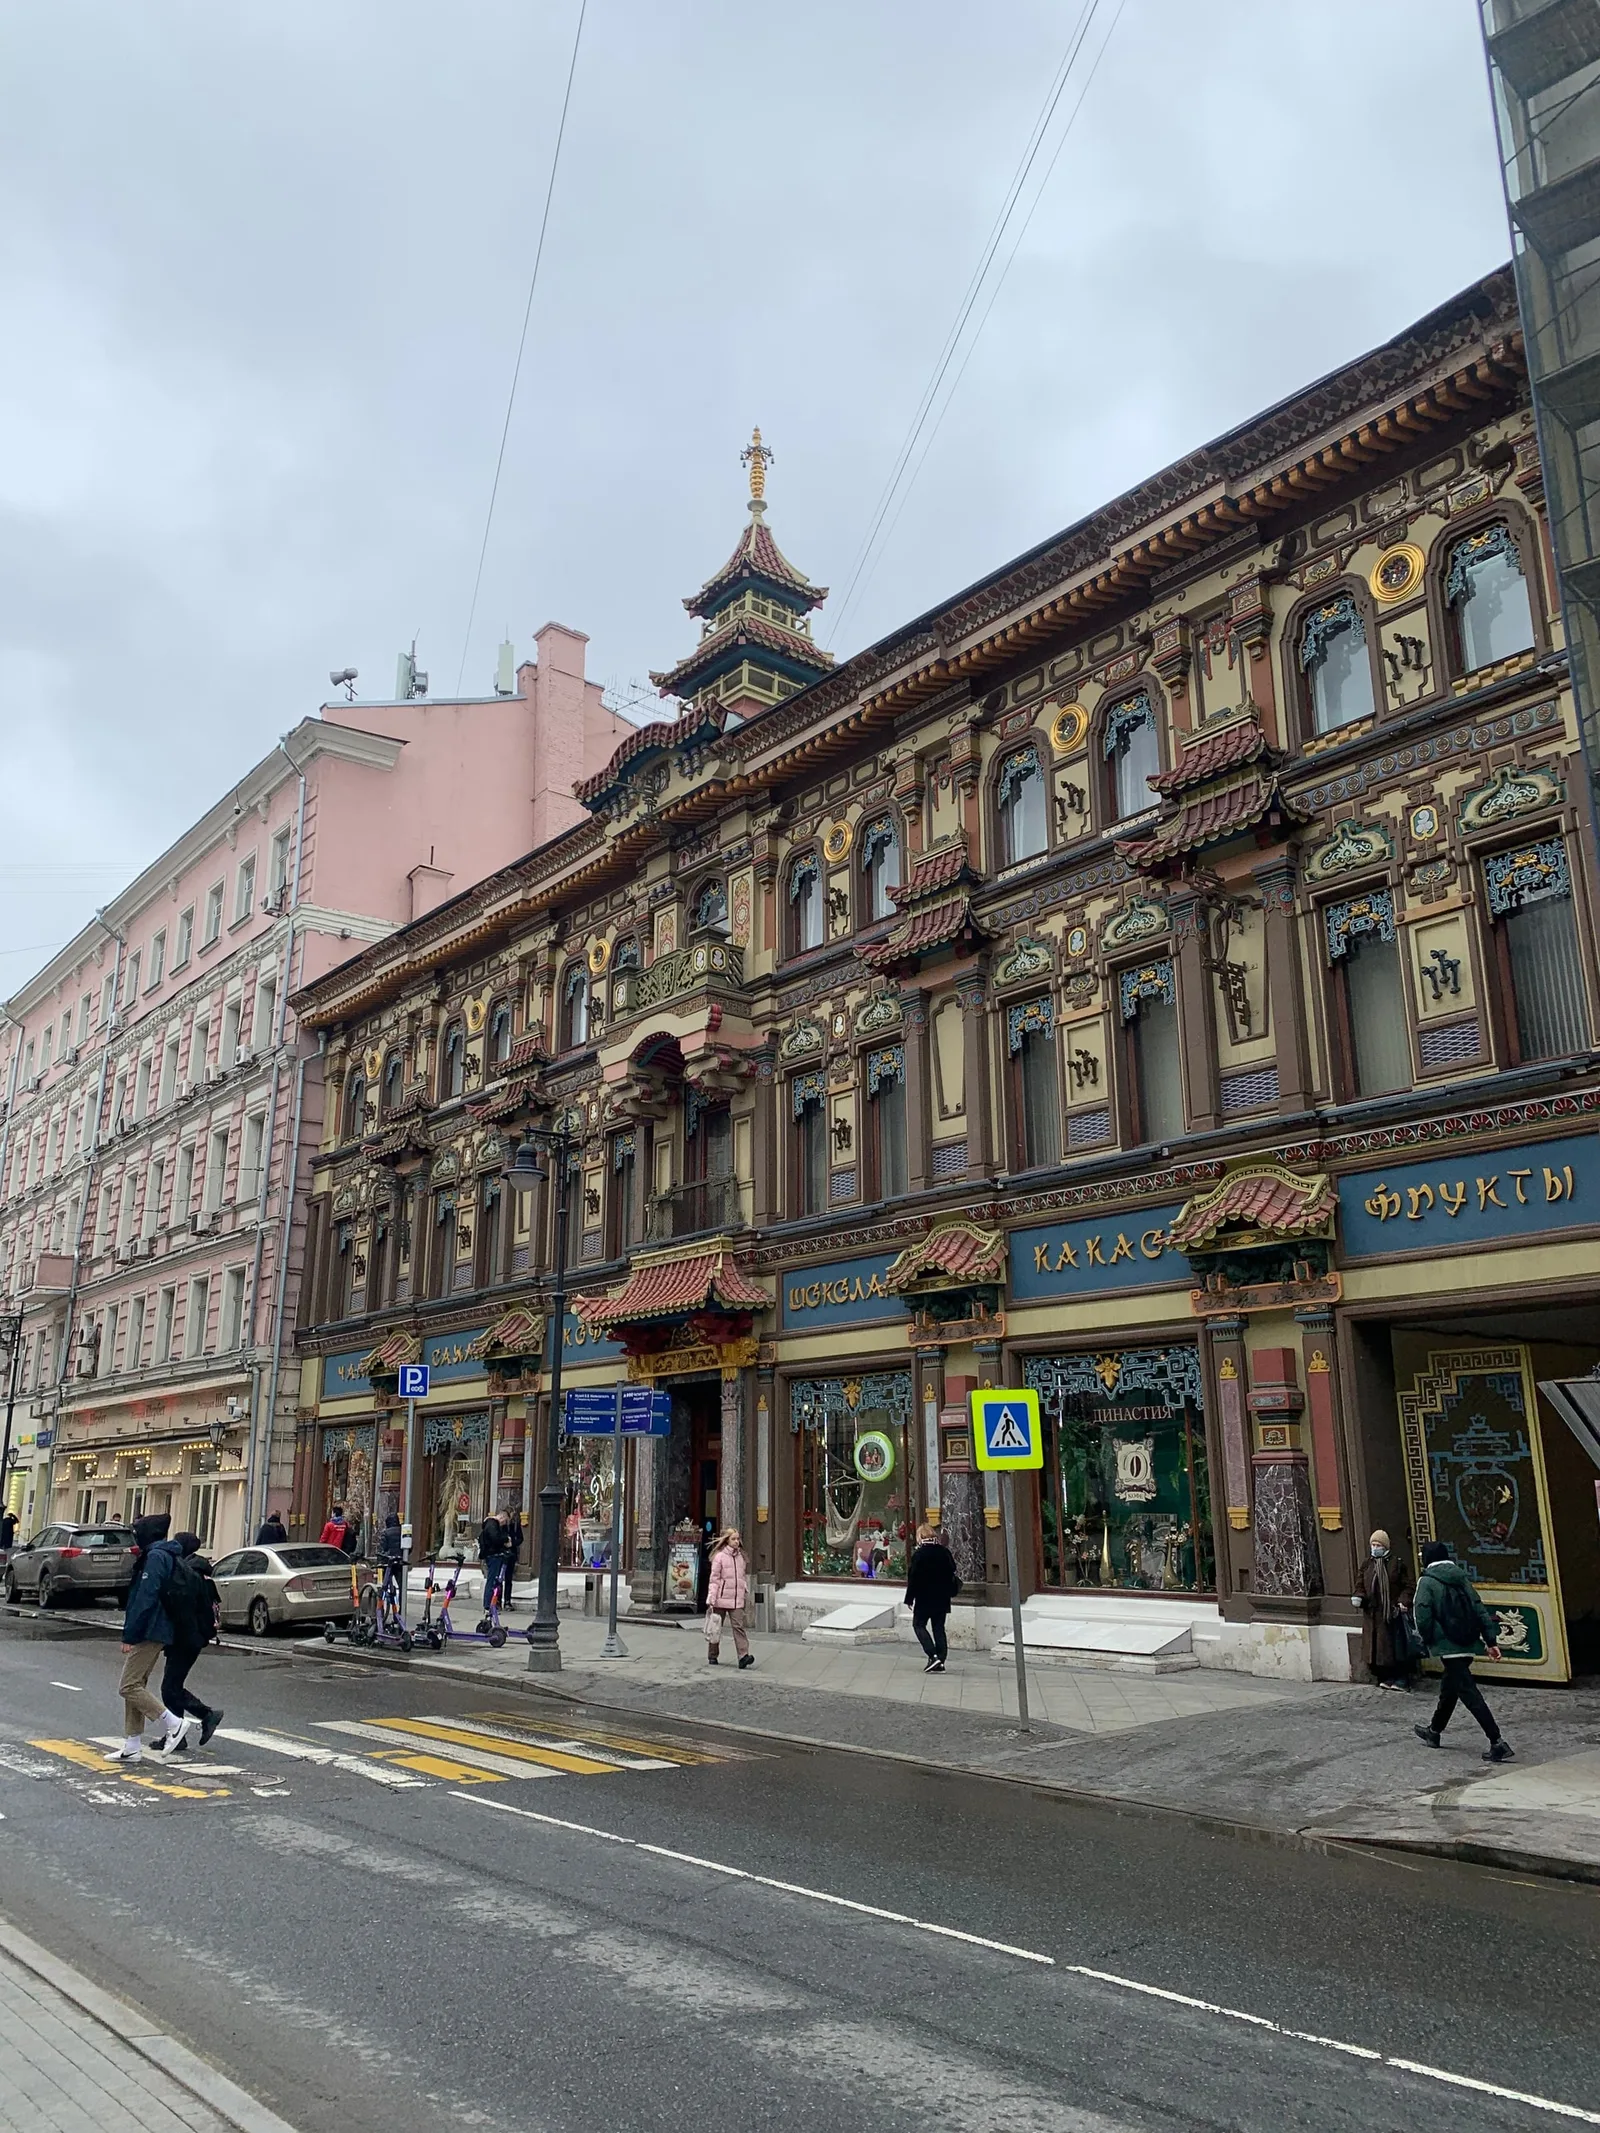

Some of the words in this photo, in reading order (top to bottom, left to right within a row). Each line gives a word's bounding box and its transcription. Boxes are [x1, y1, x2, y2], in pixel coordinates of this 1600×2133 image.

[1364, 1164, 1574, 1222] ФРУКТЫ
[788, 1272, 888, 1312] ШОКОЛА
[1092, 1405, 1173, 1425] ДИНАСТИЯ
